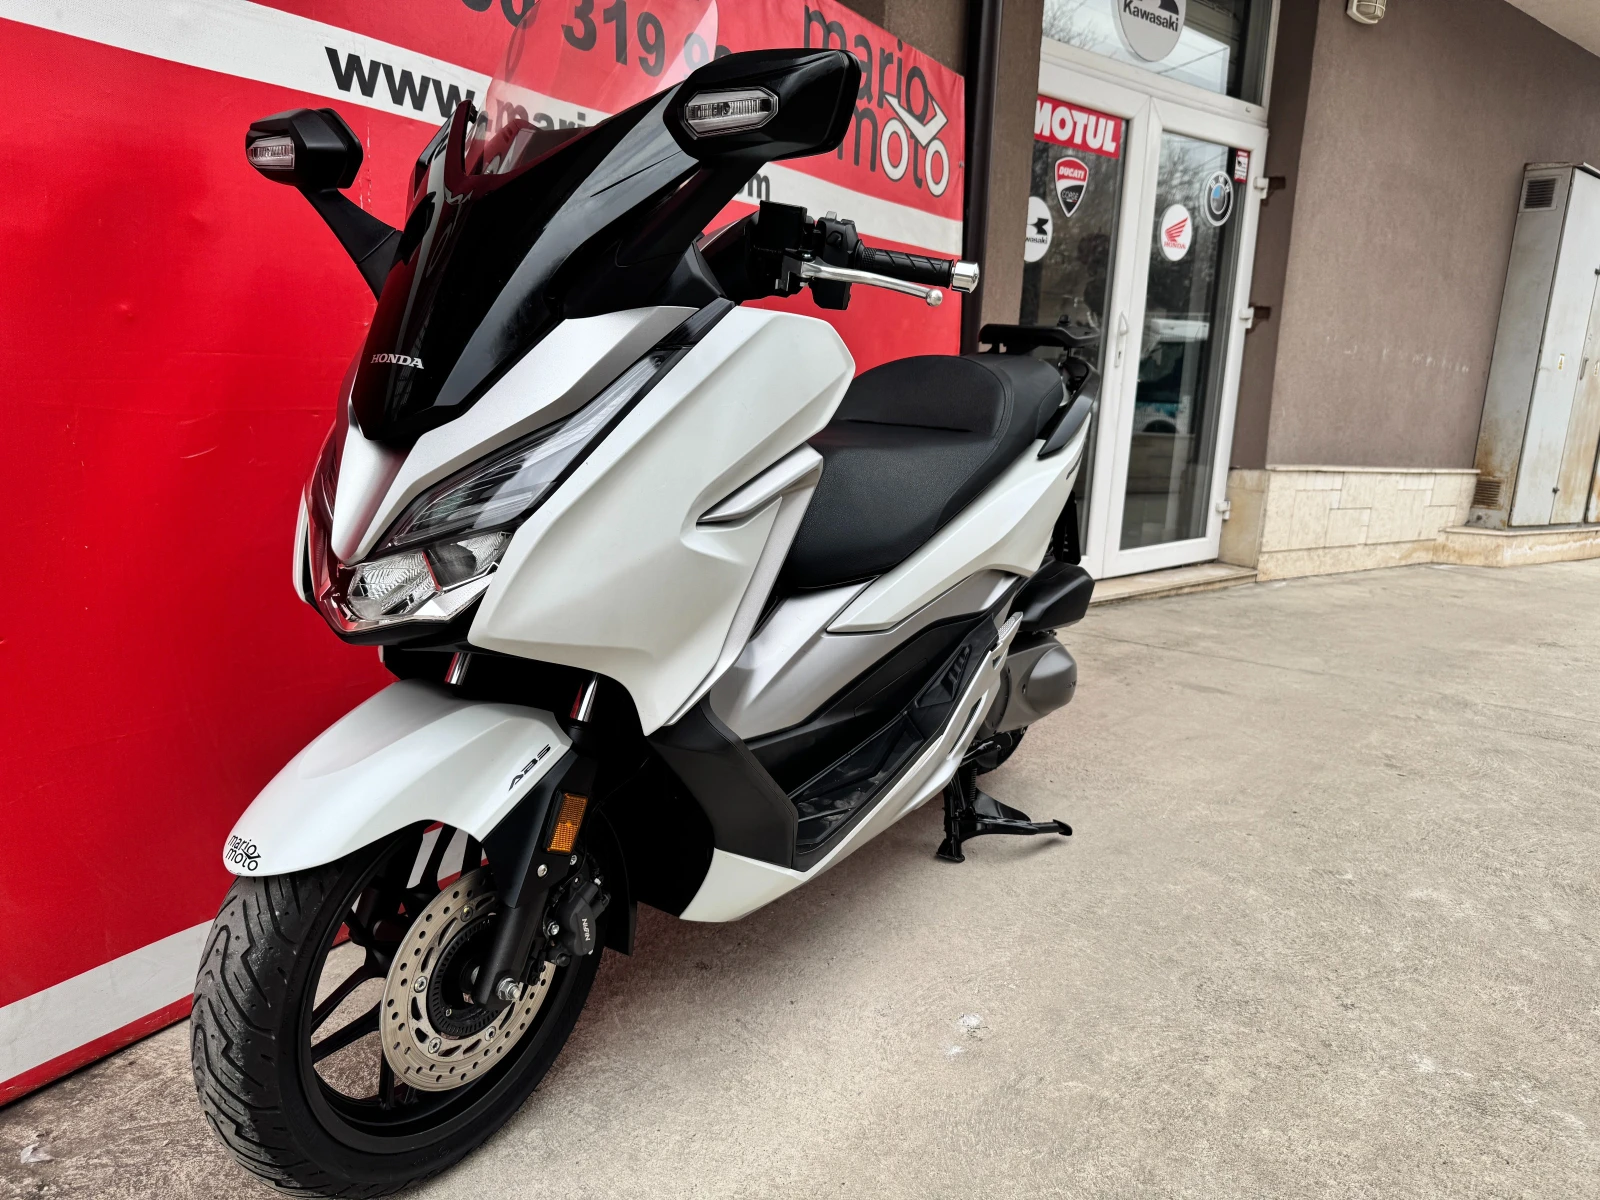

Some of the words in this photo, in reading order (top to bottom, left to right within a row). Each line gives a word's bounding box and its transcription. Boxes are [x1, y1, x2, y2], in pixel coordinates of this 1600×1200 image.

[1123, 0, 1179, 32] Kawasaki
[560, 0, 664, 77] 319
[804, 5, 928, 124] mario
[1034, 100, 1117, 153] MOTUL
[1059, 166, 1084, 179] DUCATI
[1163, 241, 1186, 250] HONDA
[370, 353, 424, 369] HONDA
[508, 743, 551, 791] ABS
[228, 835, 257, 856] mario
[225, 848, 259, 871] moto
